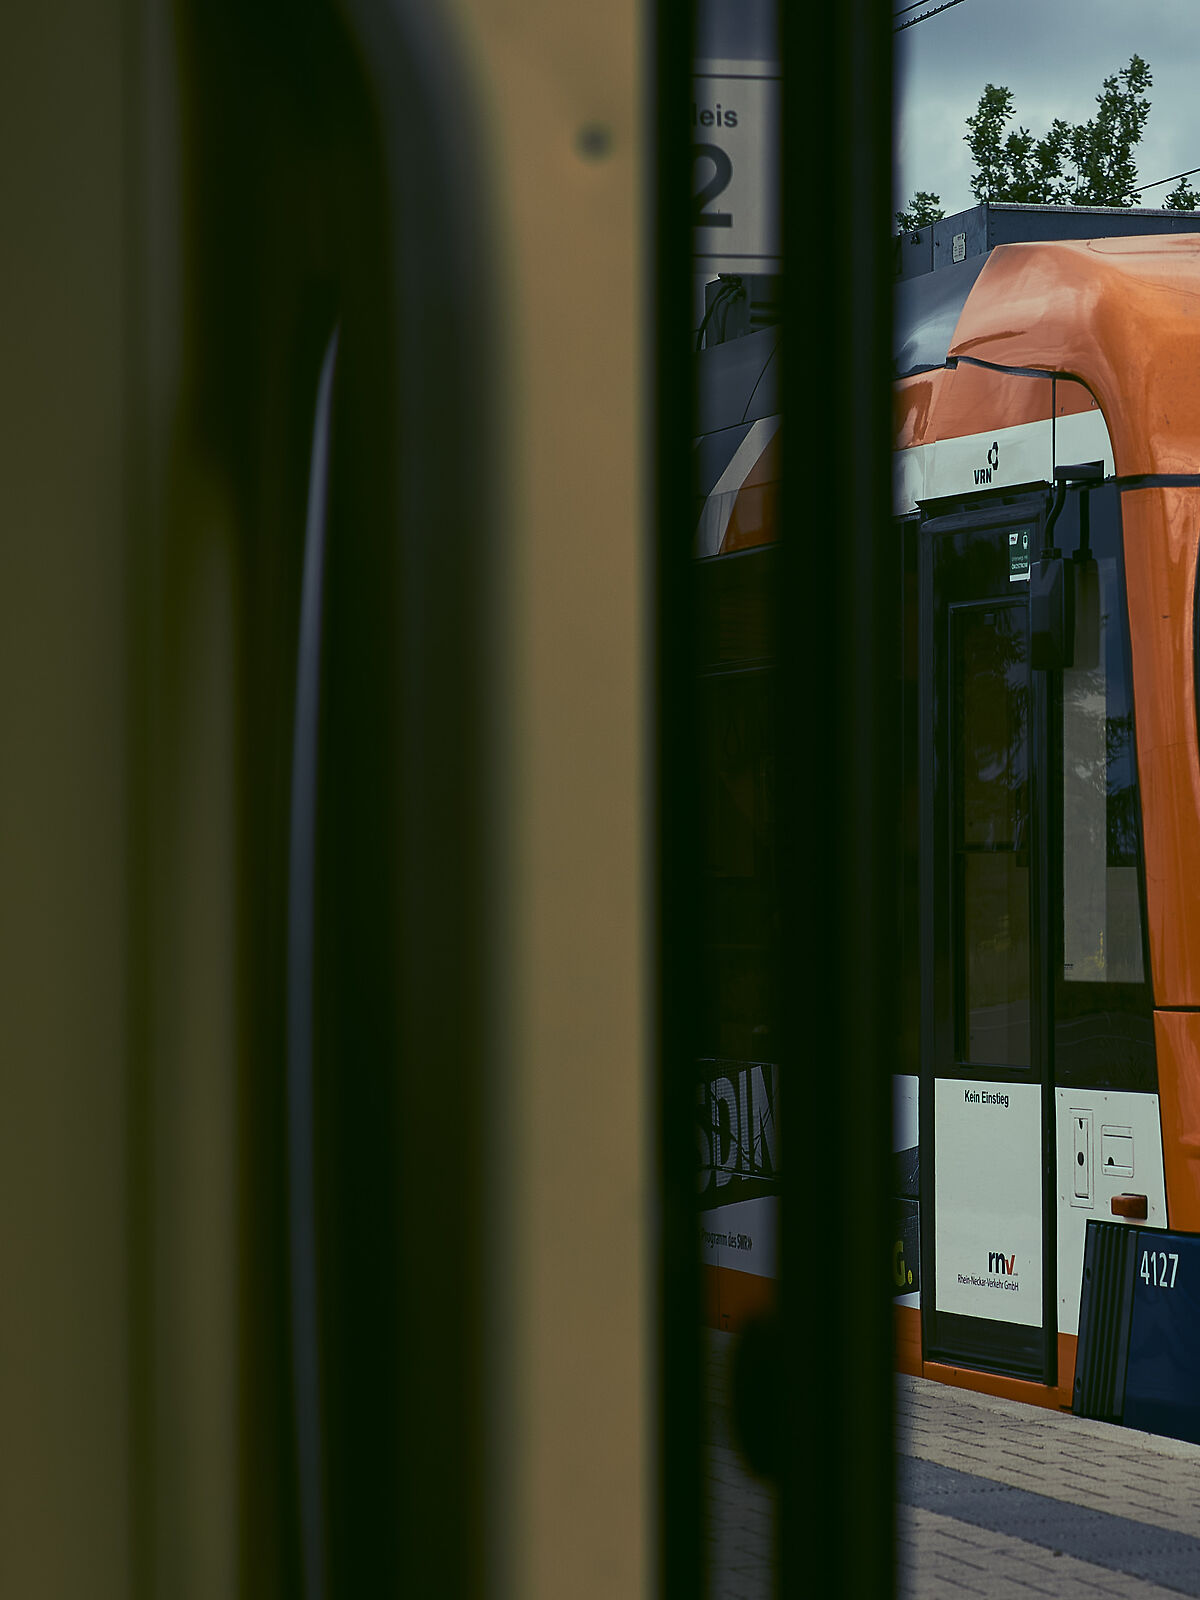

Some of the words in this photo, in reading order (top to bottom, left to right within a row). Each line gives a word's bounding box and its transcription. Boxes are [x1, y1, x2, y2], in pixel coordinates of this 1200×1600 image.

[692, 103, 738, 128] leis
[693, 143, 733, 228] 2
[974, 467, 992, 485] VRN
[964, 1089, 980, 1103] Kein
[981, 1091, 1009, 1108] Einstieg
[988, 1251, 1016, 1275] rnv
[1140, 1250, 1179, 1288] 4127
[957, 1273, 1003, 1289] Rhein-Neckar-Verkehr
[1004, 1280, 1019, 1291] GmbH
